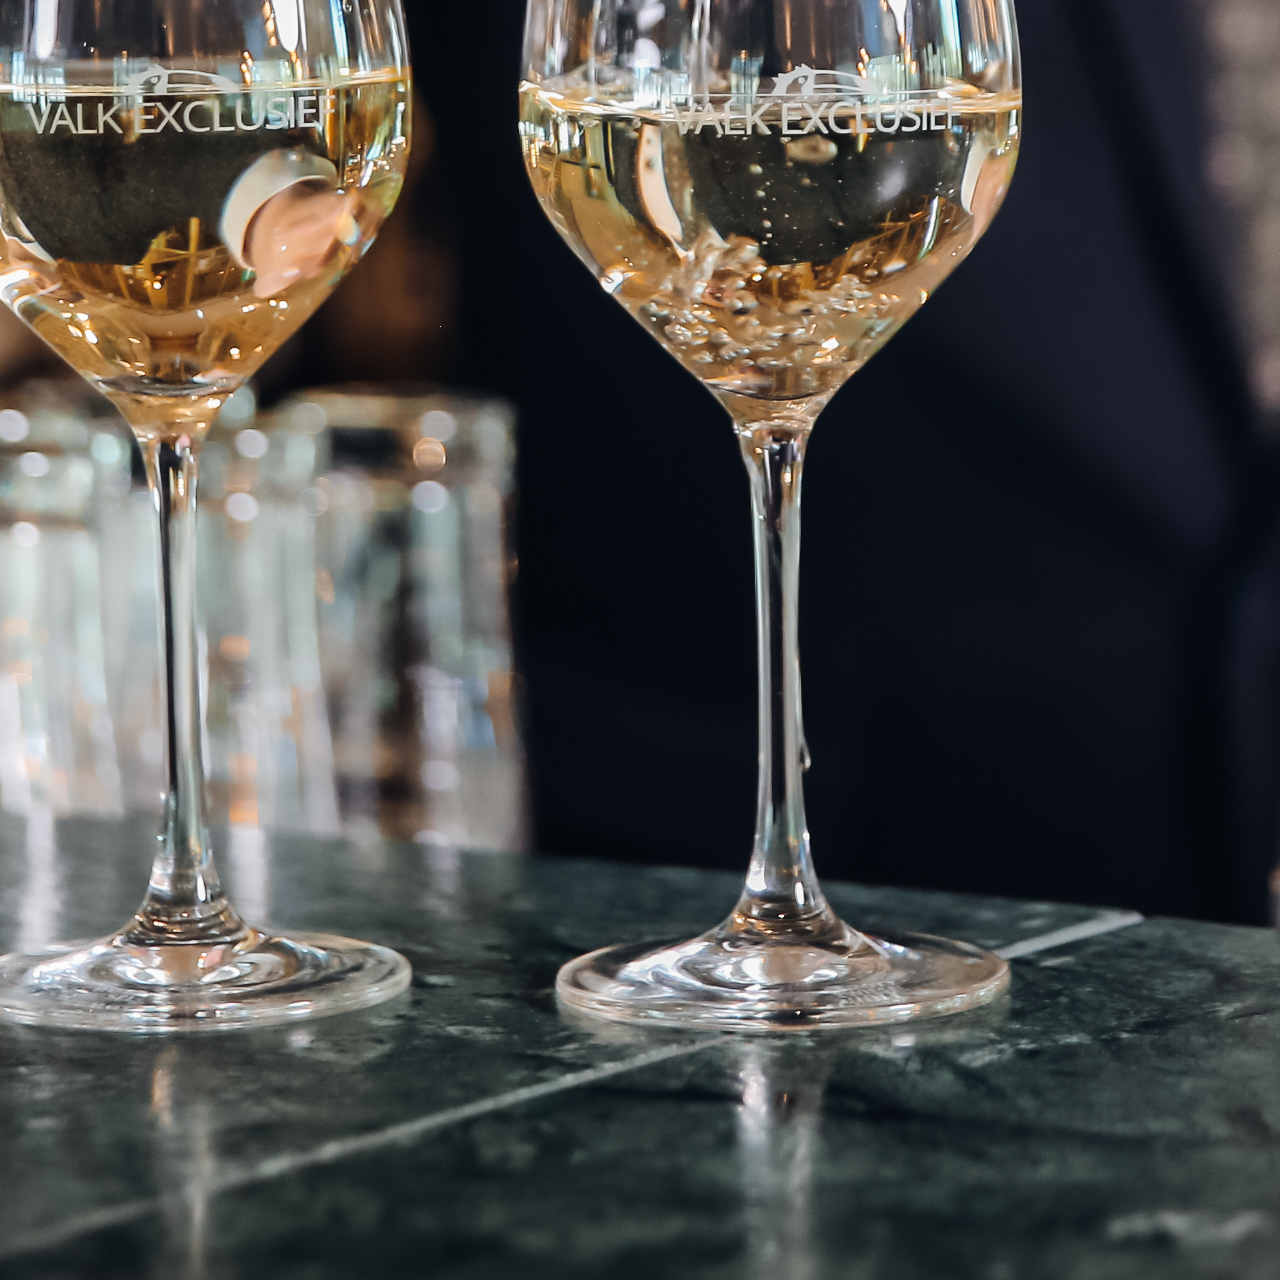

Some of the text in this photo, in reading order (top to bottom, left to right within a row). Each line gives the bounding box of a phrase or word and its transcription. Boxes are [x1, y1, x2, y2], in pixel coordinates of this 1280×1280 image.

[27, 94, 336, 134] VALK EXCLUSIEF
[671, 97, 962, 135] VALK EXCLUSIEF
